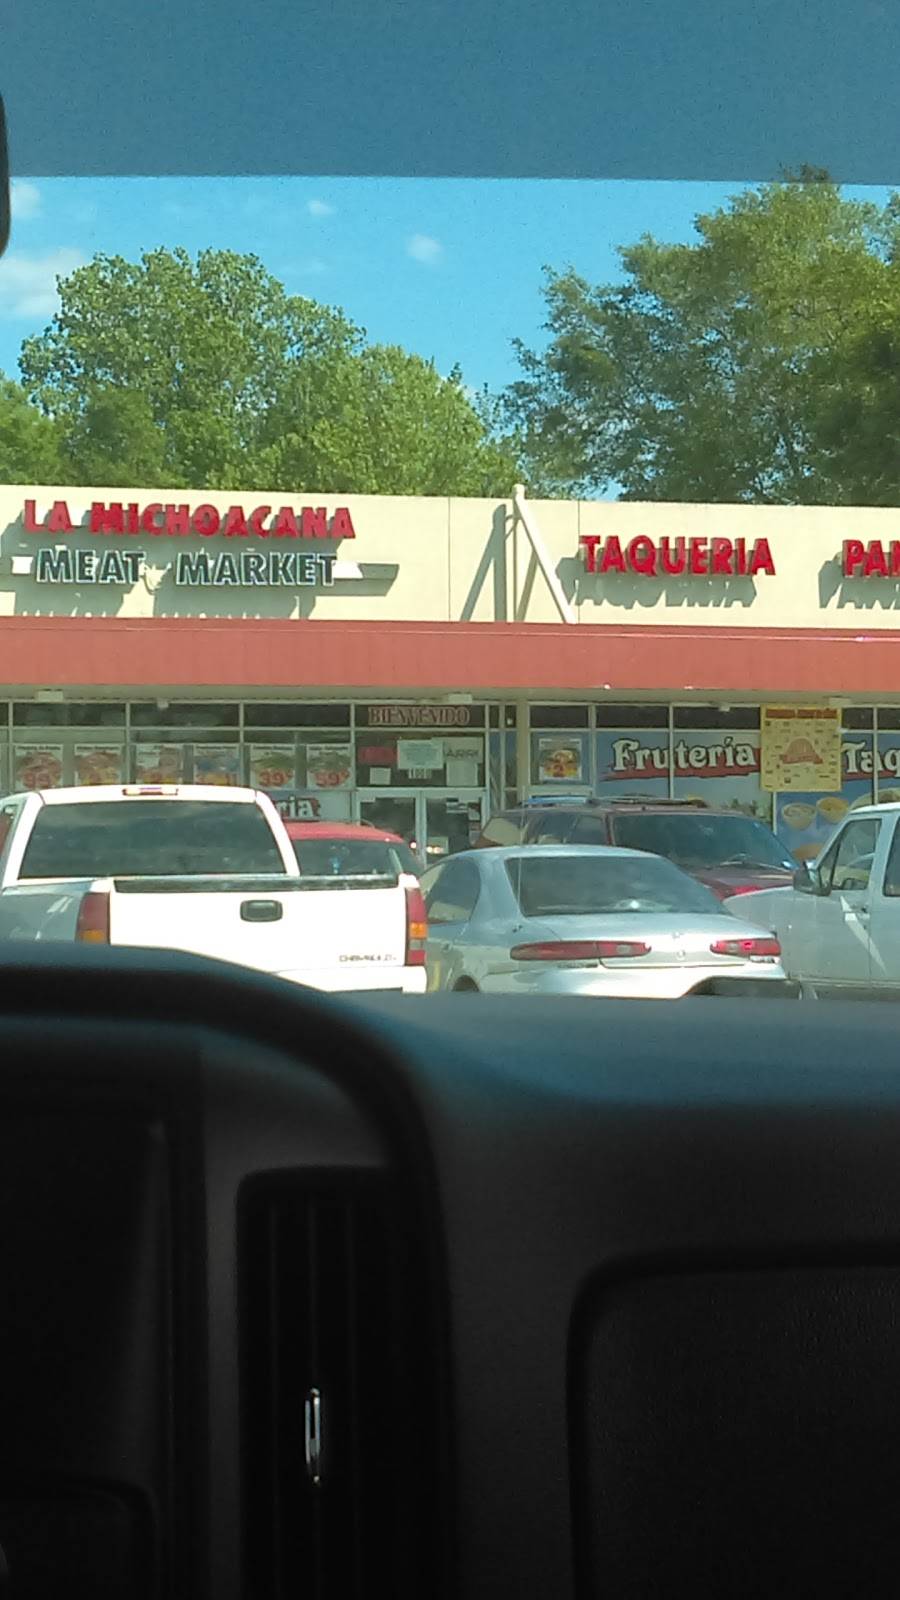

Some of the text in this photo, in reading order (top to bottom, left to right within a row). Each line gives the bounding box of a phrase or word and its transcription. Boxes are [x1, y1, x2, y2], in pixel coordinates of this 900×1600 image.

[23, 500, 357, 540] LA MICHOACANA
[36, 549, 338, 587] MEAT MARKET
[579, 535, 777, 577] TAQUERIA
[368, 706, 470, 725] BIENVENIDO
[612, 737, 756, 771] Frutería
